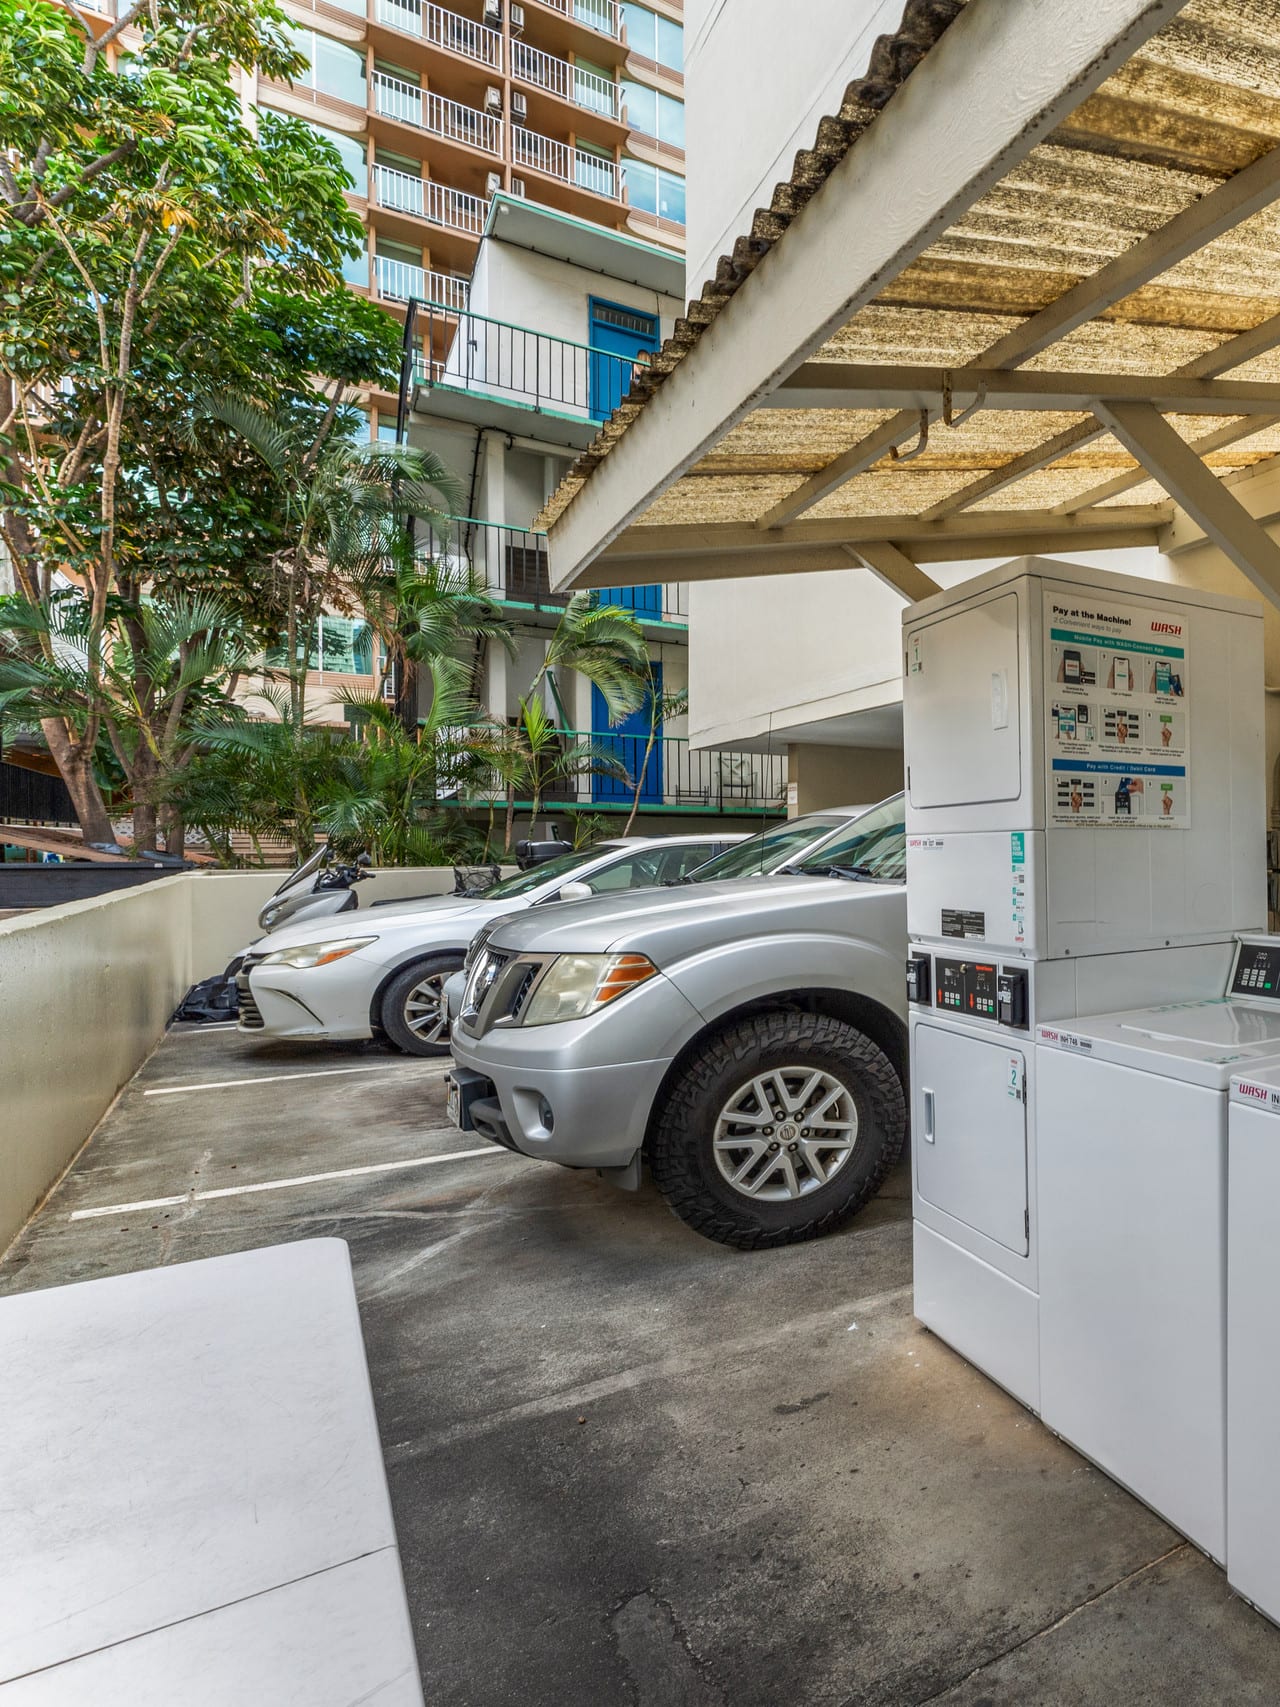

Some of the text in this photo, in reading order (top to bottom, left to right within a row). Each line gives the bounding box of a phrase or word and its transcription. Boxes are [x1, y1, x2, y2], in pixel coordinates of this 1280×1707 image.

[1052, 605, 1132, 626] Pay at the Machine!
[1150, 621, 1182, 636] WASH
[1041, 1029, 1059, 1041] WASH
[1011, 1069, 1017, 1086] 2
[1239, 1083, 1268, 1100] WASH
